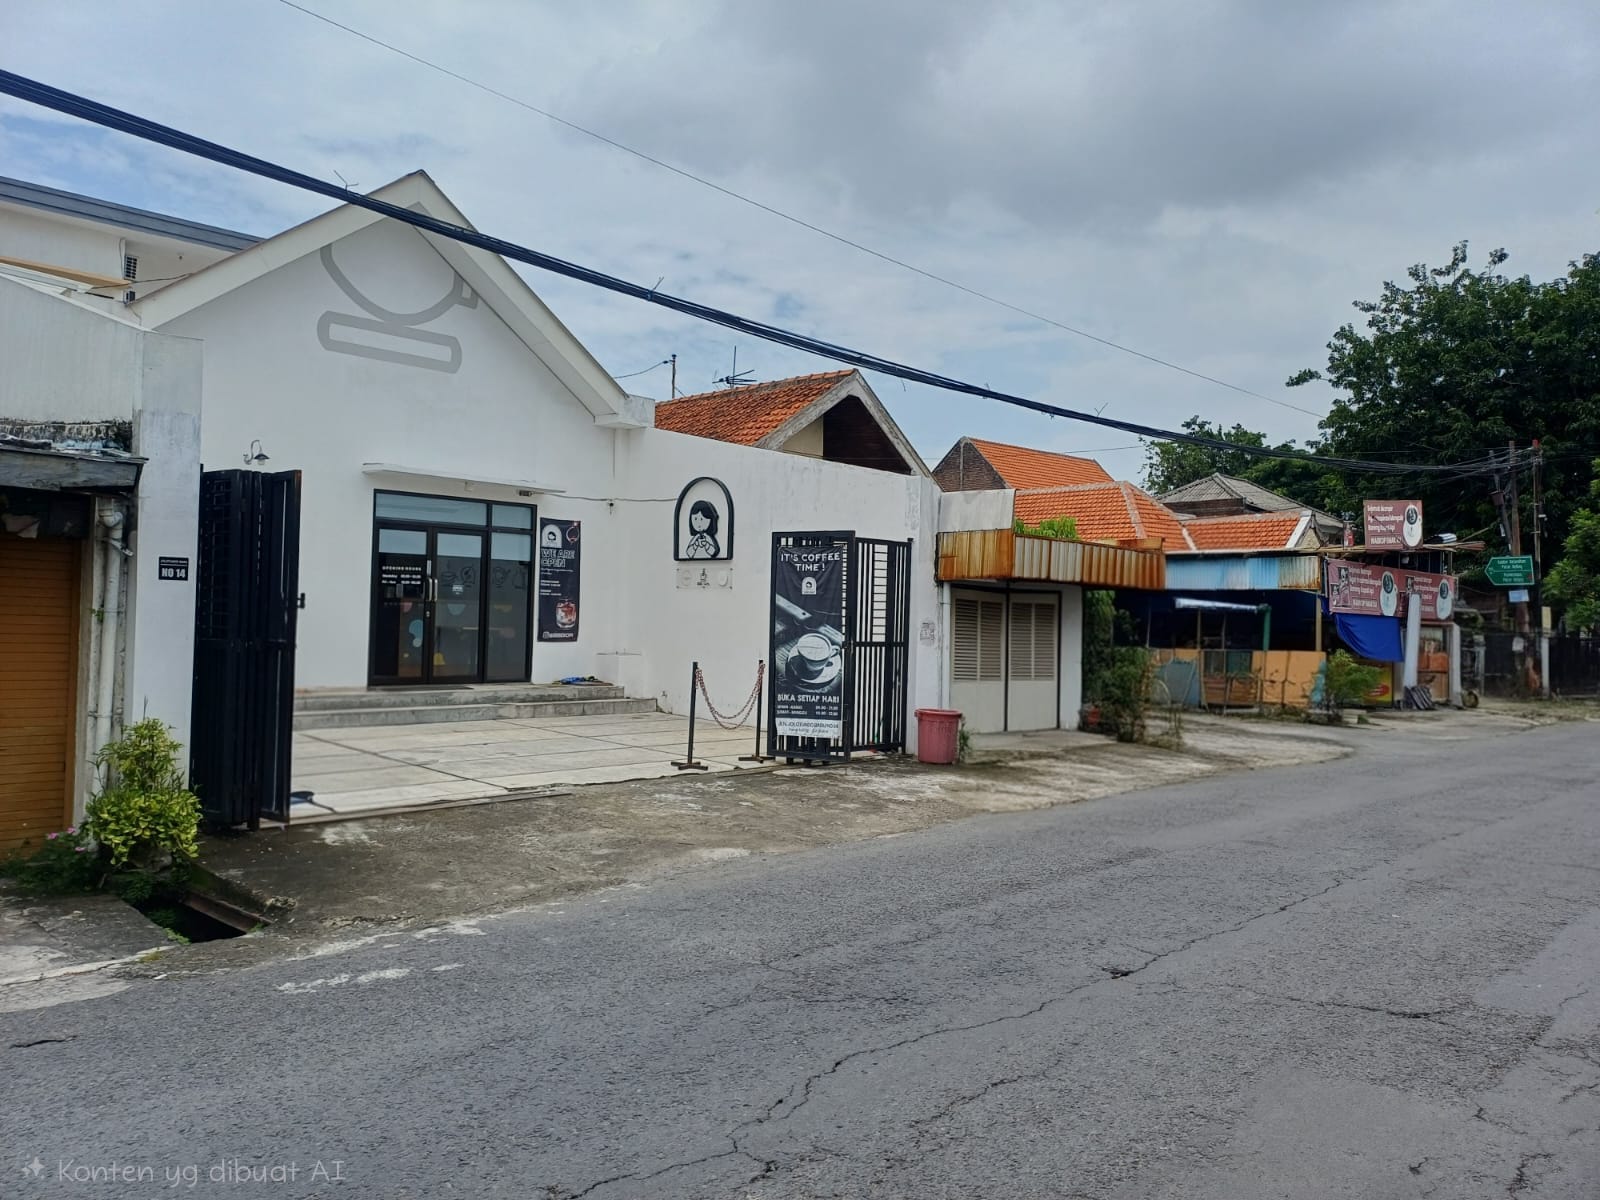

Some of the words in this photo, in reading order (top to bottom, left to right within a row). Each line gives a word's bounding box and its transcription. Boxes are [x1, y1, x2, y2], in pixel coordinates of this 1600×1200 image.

[780, 553, 798, 562] IT'S
[801, 552, 841, 562] COFFEE
[541, 558, 566, 568] OPEN
[795, 563, 820, 572] TIME
[161, 567, 174, 578] NO
[175, 568, 186, 578] 14
[777, 694, 796, 702] BUKA
[797, 694, 820, 703] SETIAP
[821, 695, 840, 704] HARI
